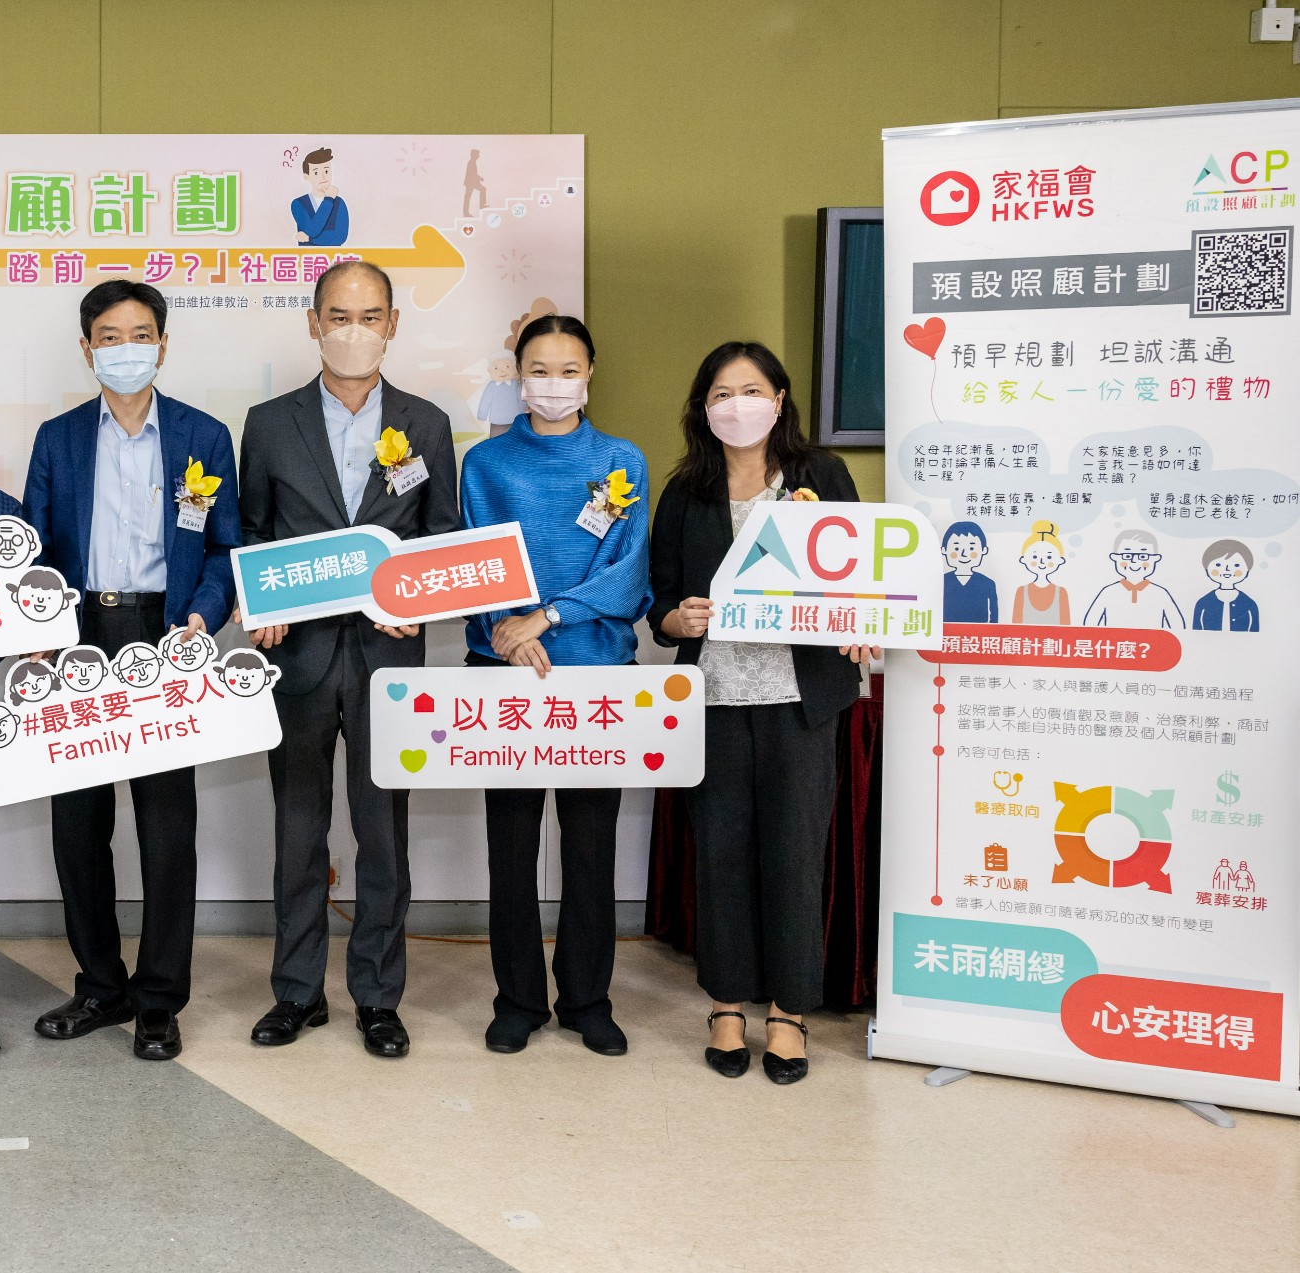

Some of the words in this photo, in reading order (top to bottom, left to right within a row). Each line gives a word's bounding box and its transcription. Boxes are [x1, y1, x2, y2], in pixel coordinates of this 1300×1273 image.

[992, 164, 1097, 200] 家福會
[1193, 149, 1290, 188] ACP
[991, 198, 1095, 222] HKFWS
[1185, 193, 1296, 213] 預設照顧計劃
[930, 263, 1171, 301] 預設照顧計劃
[951, 340, 1075, 369] 預早規劃
[1100, 336, 1237, 366] 坦誠溝通
[961, 377, 1271, 404] 給家人一份愛的禮物
[914, 443, 1039, 456] 父母年紀漸長，如何
[914, 457, 1039, 469] 開口討論準備人生最
[1082, 445, 1202, 458] 大家族意見多，你
[914, 470, 965, 482] 後一程？
[1082, 473, 1137, 484] 成共識？
[1083, 459, 1201, 472] 一言我一語如何達
[966, 505, 1033, 517] 我辦後事？
[1149, 506, 1252, 520] 安排自己老後？
[734, 513, 920, 582] ACP
[258, 549, 370, 592] 未雨綢繆
[394, 558, 507, 599] 心安理得
[719, 602, 933, 638] 預設照顧計劃
[23, 673, 225, 737] #最緊要一家人
[452, 695, 624, 731] 以家為本
[48, 731, 132, 763] Family
[140, 714, 201, 745] First
[450, 744, 527, 771] Family
[534, 744, 626, 766] Matters
[974, 801, 1041, 819] 醫療取向
[1191, 808, 1265, 828] 財產安排
[963, 874, 1029, 892] 未了心願
[1196, 891, 1268, 912] 殯葬安排
[913, 939, 1066, 985] 未雨綢繆
[1091, 1001, 1255, 1052] 心安理得
